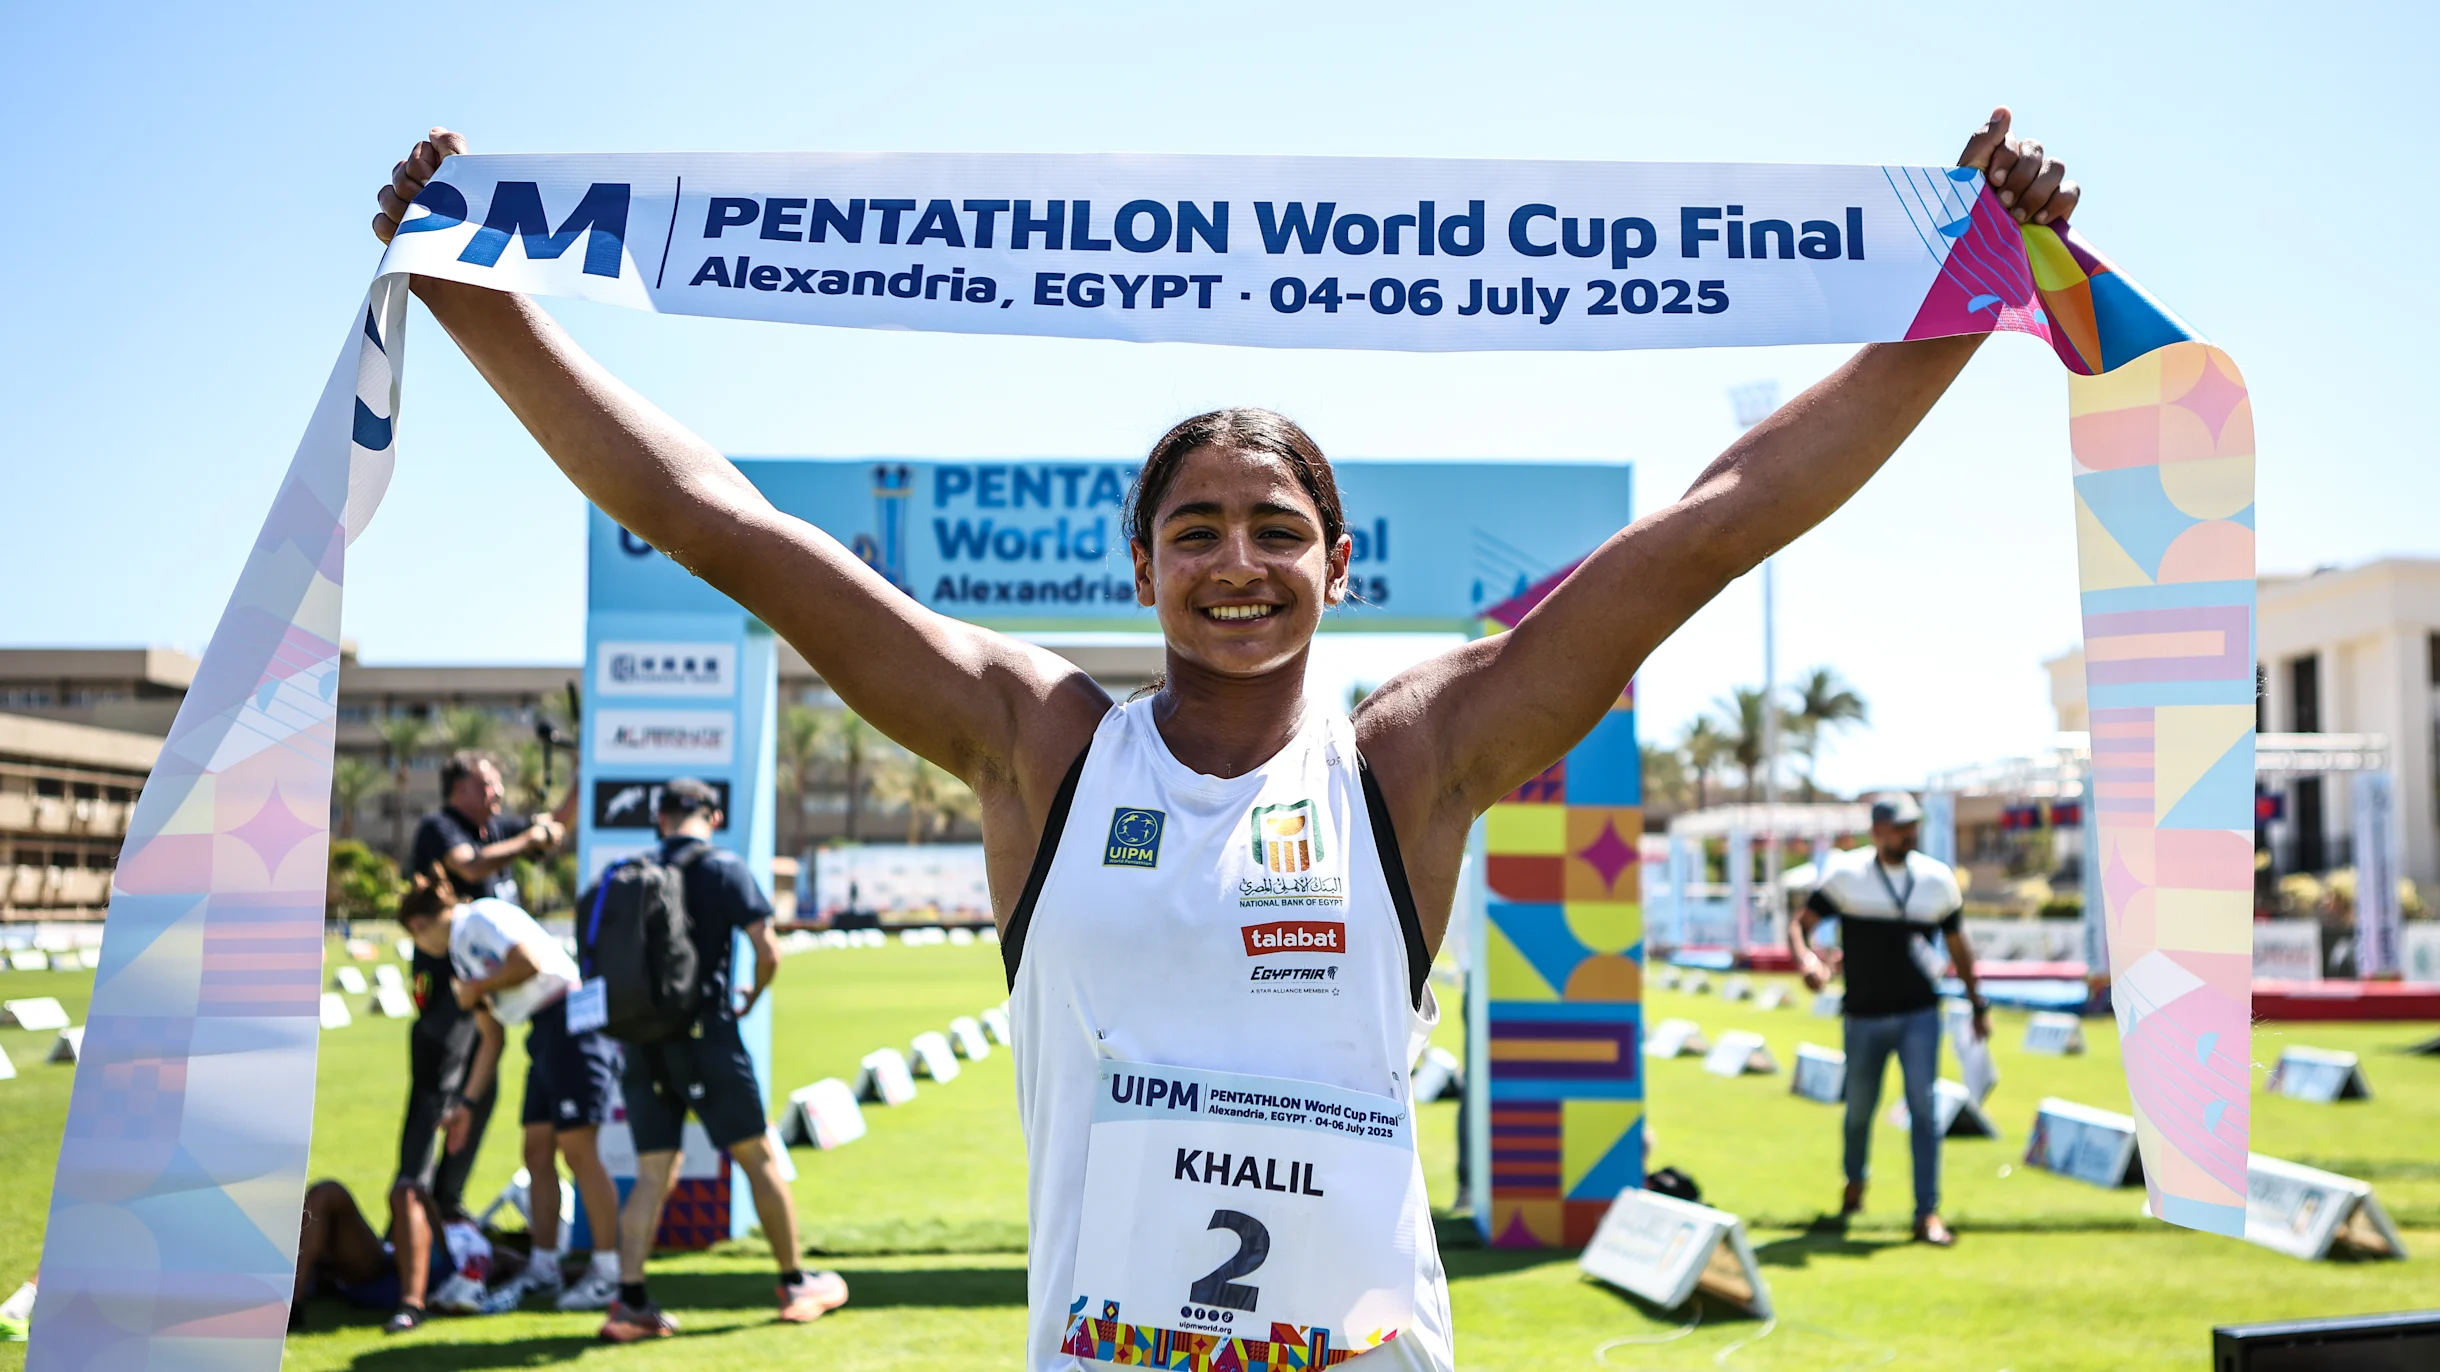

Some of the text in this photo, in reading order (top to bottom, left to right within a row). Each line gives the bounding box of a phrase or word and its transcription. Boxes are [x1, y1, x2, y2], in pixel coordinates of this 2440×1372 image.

[704, 197, 1864, 269] PENTATHLON World Cup Final
[689, 256, 1011, 308] Alexandria,
[1034, 273, 1222, 309] EGYPT
[1269, 277, 1443, 316] 04-06
[1458, 278, 1570, 325] July
[1587, 279, 1730, 315] 2025
[933, 516, 1108, 562] World
[1109, 846, 1153, 862] UIPM
[1240, 900, 1280, 908] NATIONAL
[1281, 899, 1304, 907] BANK
[1318, 899, 1344, 907] EGYPT
[1251, 927, 1337, 948] talabat
[1111, 1073, 1199, 1112] UIPM
[1210, 1089, 1399, 1127] PENTATHLON World Cup Final
[1208, 1104, 1268, 1121] Alexandria,
[1270, 1111, 1307, 1124] EGYPT
[1315, 1117, 1344, 1131] 04-06
[1345, 1123, 1365, 1136] July
[1367, 1126, 1393, 1138] 2025
[1174, 1148, 1324, 1197] KHALIL
[1189, 1209, 1271, 1313] 2
[1179, 1321, 1232, 1335] uipmworld.org
